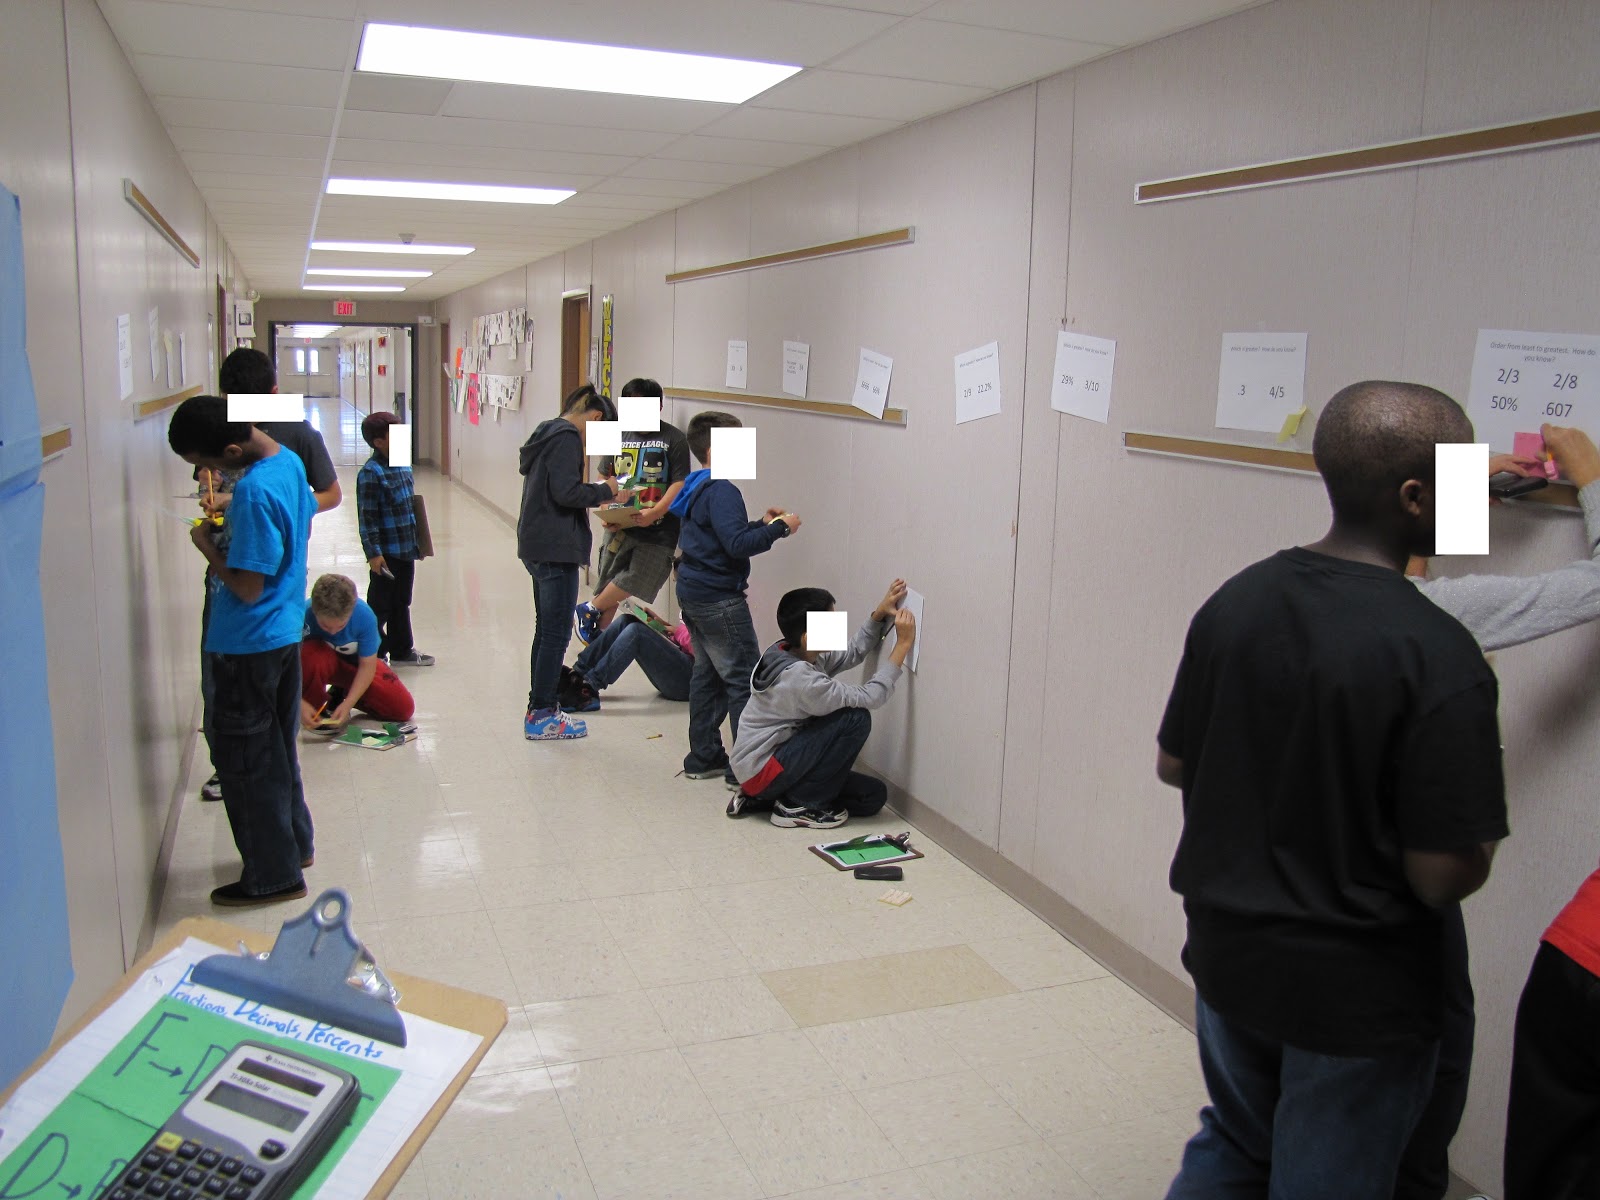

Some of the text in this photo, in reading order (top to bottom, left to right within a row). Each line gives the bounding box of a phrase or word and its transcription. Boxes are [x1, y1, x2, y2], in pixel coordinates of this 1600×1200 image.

[337, 302, 353, 315] EXIT
[602, 294, 612, 398] WELCO
[1490, 342, 1506, 350] Order
[1507, 342, 1520, 350] from
[1522, 344, 1534, 352] least
[1536, 354, 1556, 362] know?
[1061, 374, 1099, 392] 29% 3/10
[1497, 368, 1578, 390] 2/3 2/8
[1238, 384, 1285, 399] .3 4/5
[1490, 396, 1572, 418] 50% .607
[233, 998, 302, 1038] Decimals,
[306, 1022, 384, 1059] Percents
[254, 1080, 272, 1092] Solar
